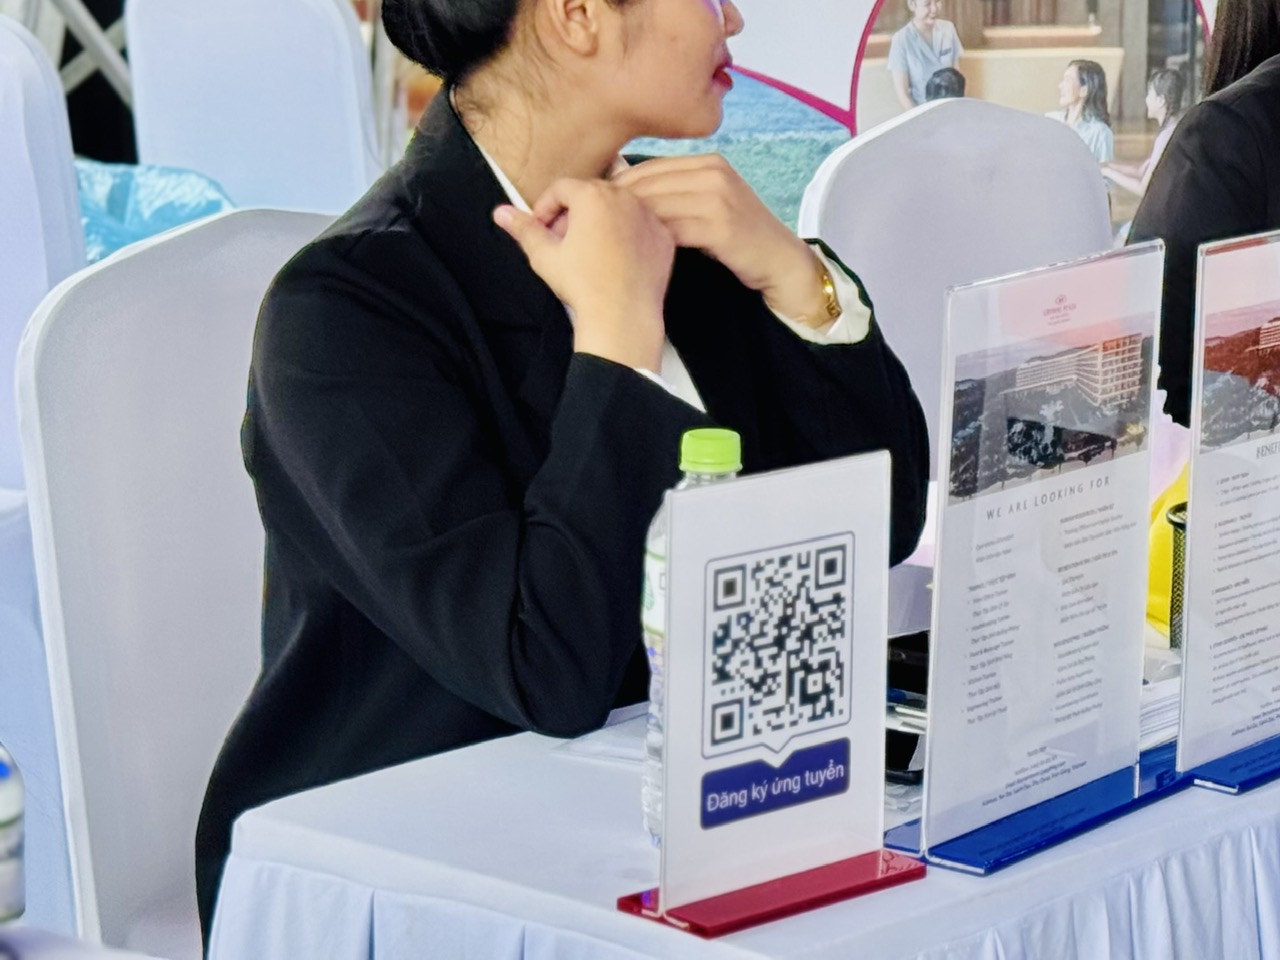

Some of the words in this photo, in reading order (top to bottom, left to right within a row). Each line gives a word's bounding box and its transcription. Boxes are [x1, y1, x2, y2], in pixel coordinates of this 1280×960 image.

[1034, 484, 1084, 507] LOOKING
[706, 789, 748, 813] Đăng
[751, 779, 769, 804] ký
[771, 775, 801, 795] ứng
[804, 759, 845, 788] tuyển
